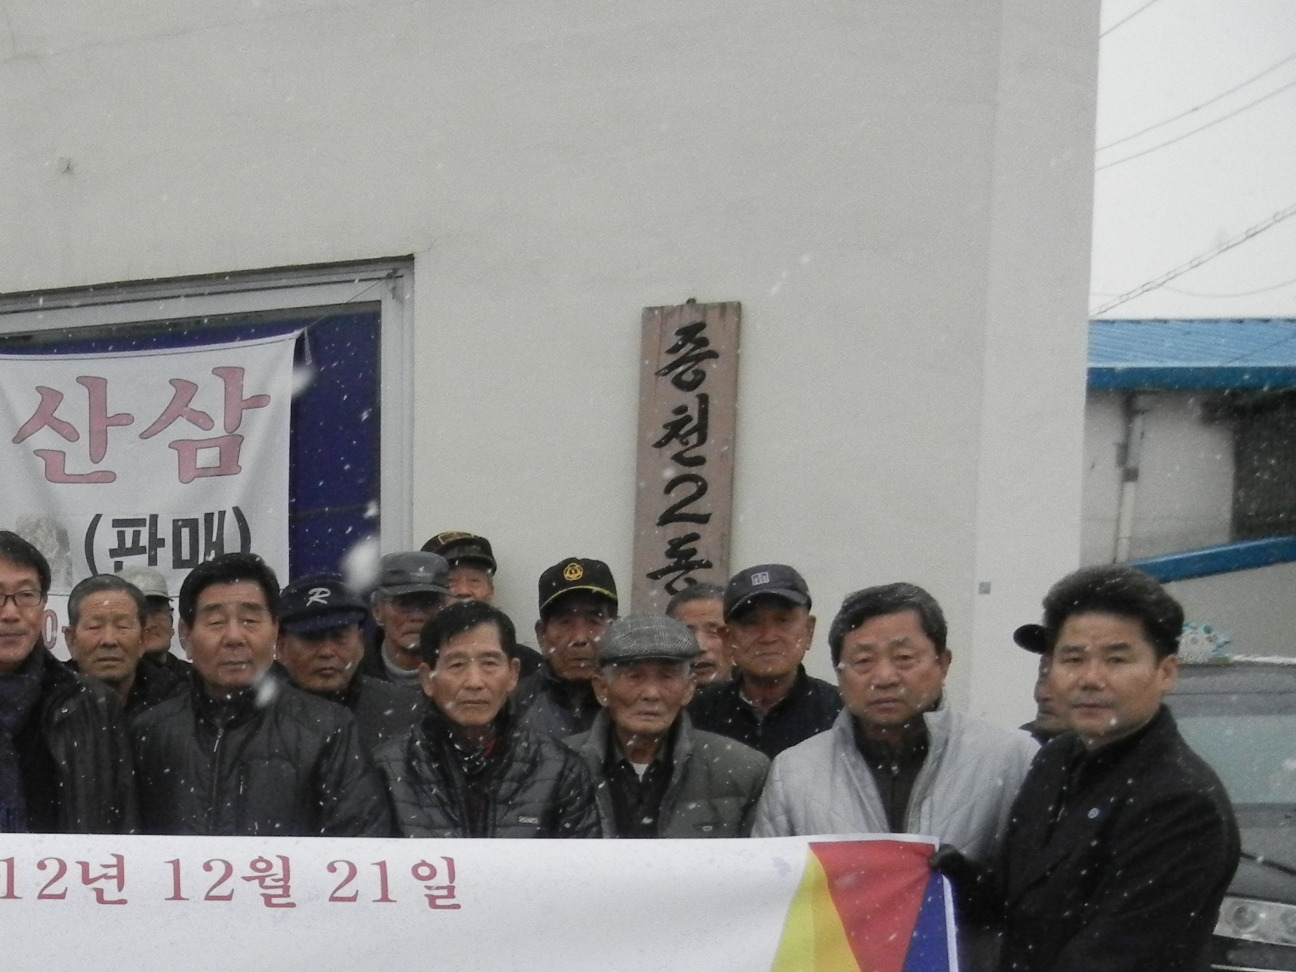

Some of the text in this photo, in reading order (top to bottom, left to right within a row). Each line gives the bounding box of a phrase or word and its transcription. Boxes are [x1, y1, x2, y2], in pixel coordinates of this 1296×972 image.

[11, 366, 271, 484] 산삼
[84, 506, 252, 577] (판매)
[164, 854, 298, 911] 12월
[326, 856, 464, 911] 21일
